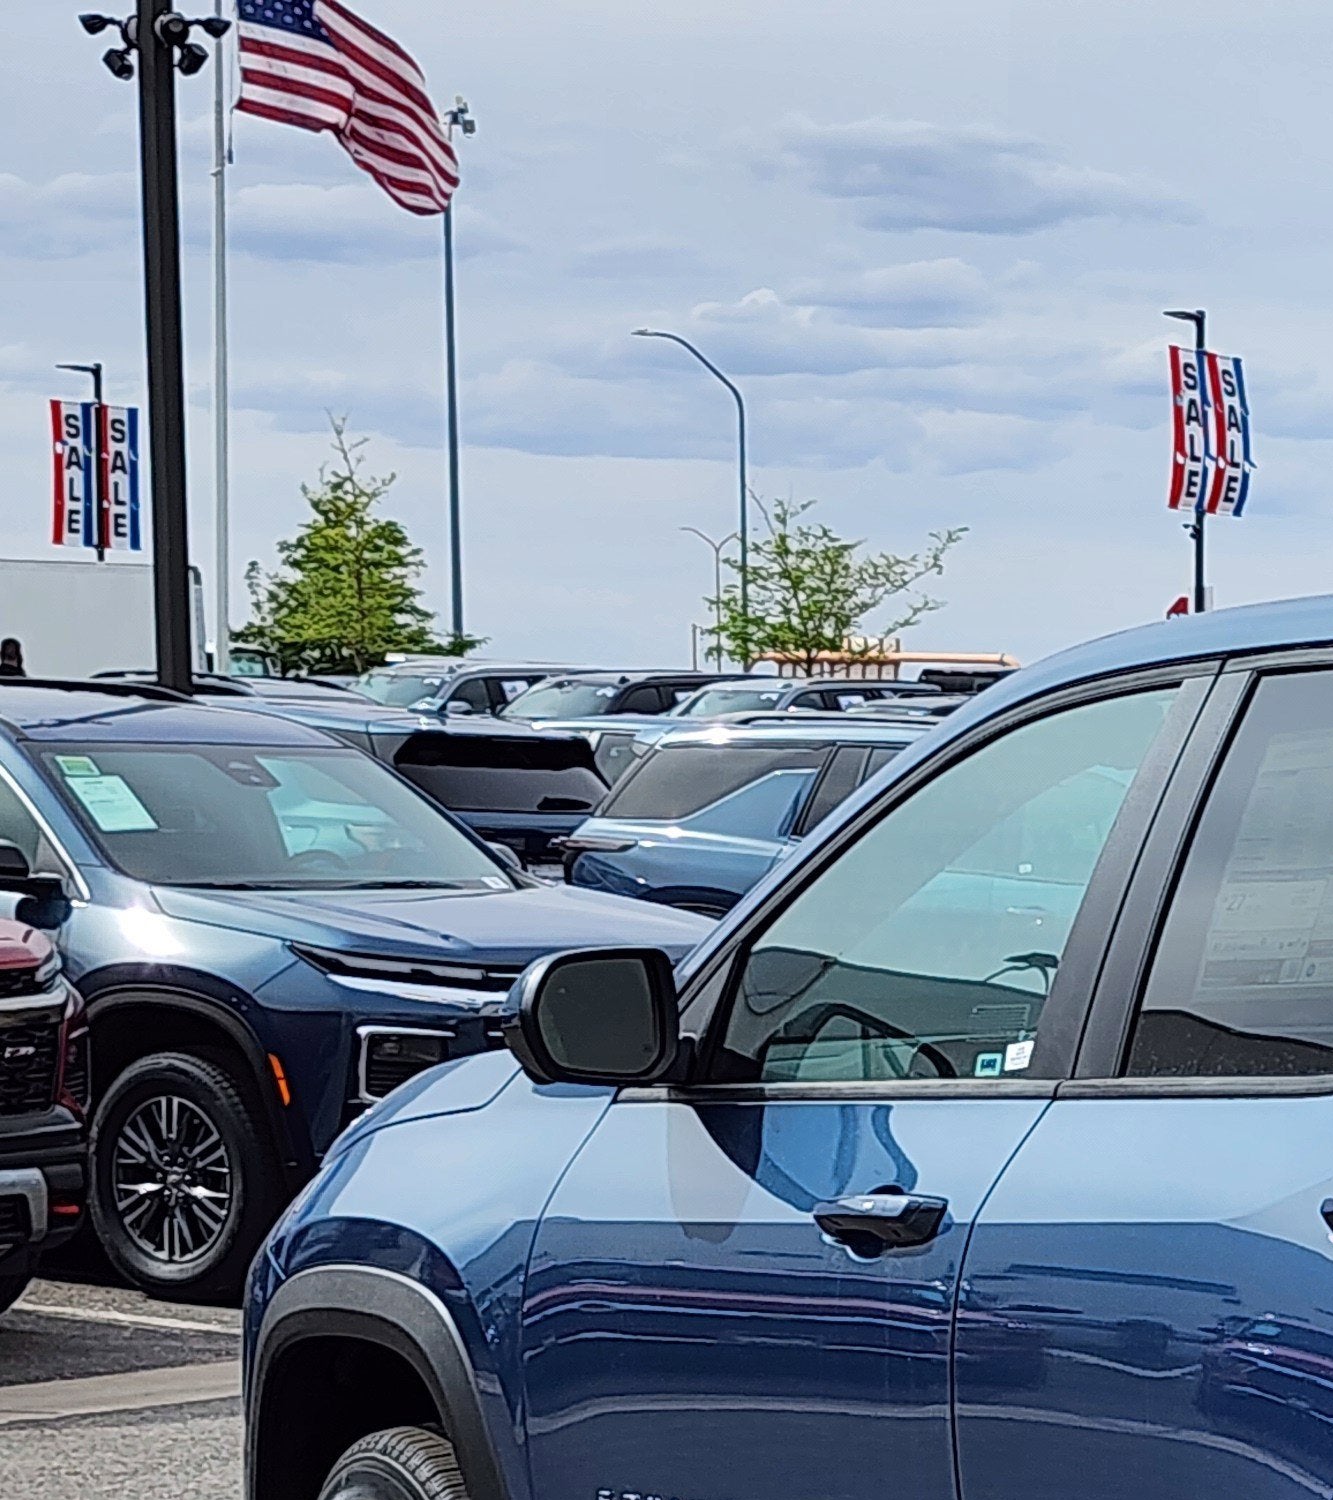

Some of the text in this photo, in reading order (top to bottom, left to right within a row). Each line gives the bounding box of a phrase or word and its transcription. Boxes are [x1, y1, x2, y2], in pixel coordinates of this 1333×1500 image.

[64, 412, 84, 535] SALE
[110, 417, 128, 539] SALE
[1182, 361, 1203, 499] SALE
[1221, 367, 1242, 504] SALE
